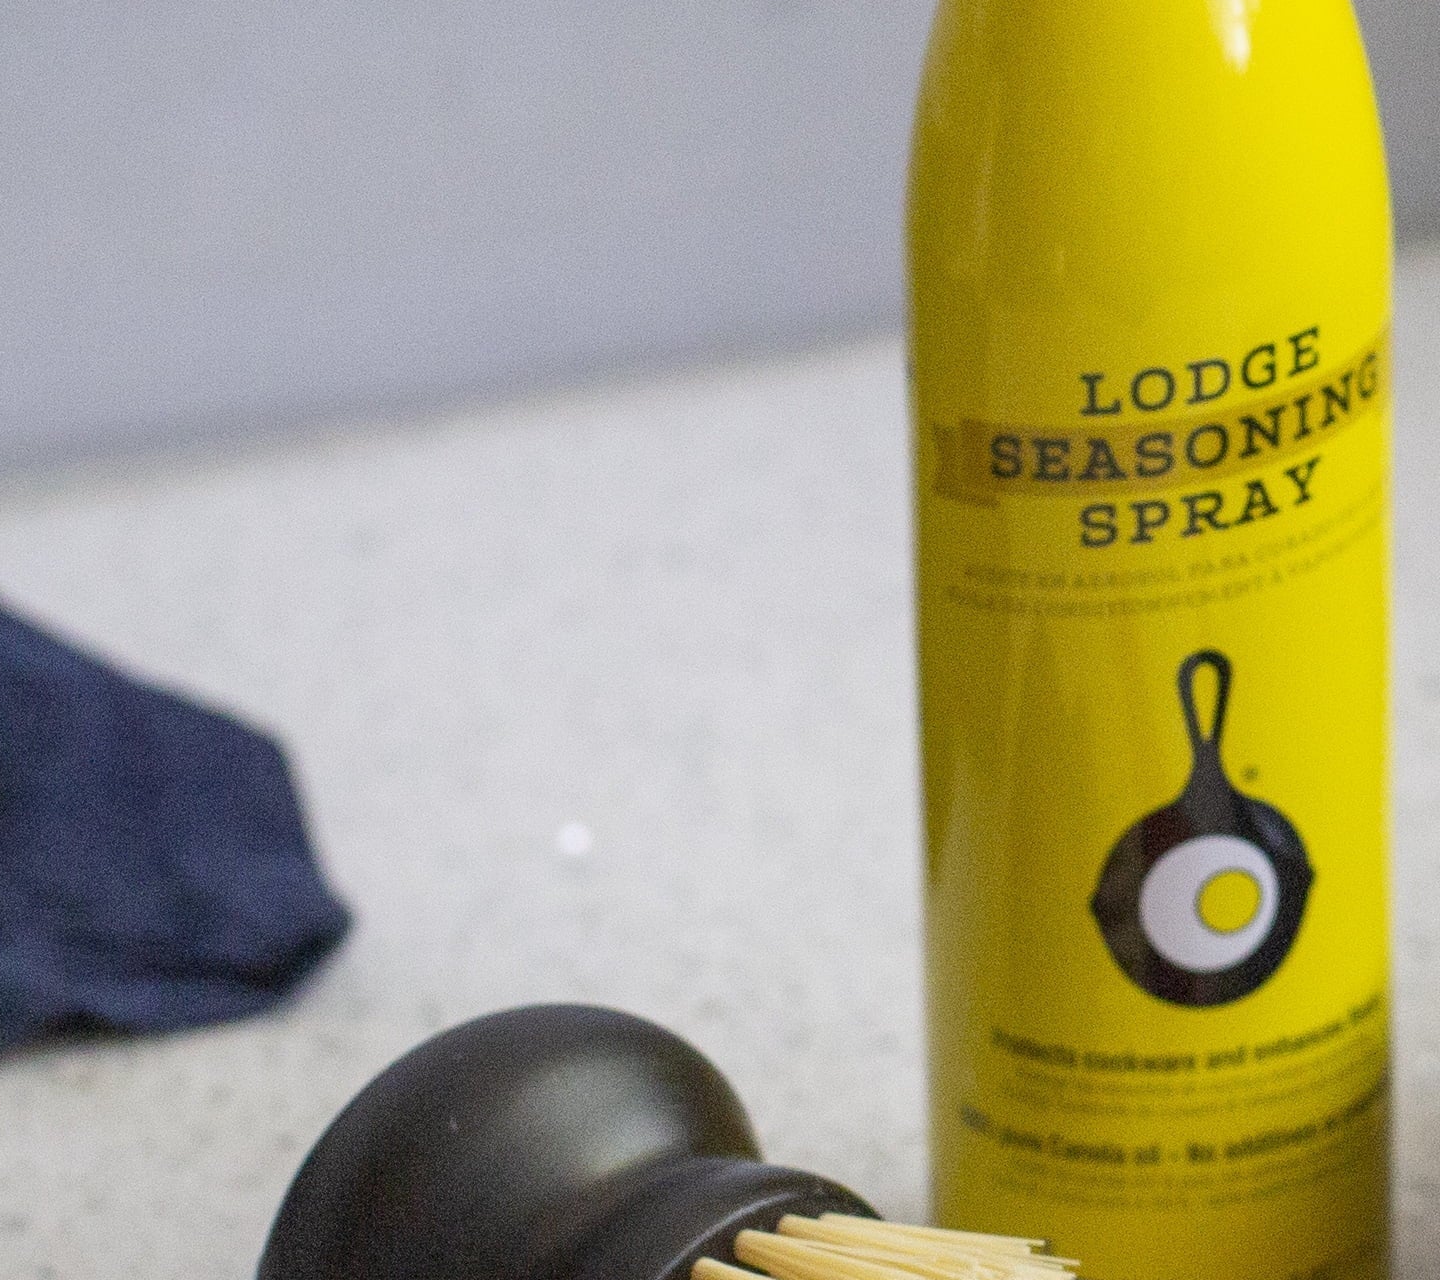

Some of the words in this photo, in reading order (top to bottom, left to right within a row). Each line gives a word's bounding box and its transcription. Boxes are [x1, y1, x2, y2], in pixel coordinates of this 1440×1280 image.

[988, 351, 1380, 484] SEASONING
[1078, 325, 1322, 418] LODGE
[1078, 455, 1323, 550] SPRAY
